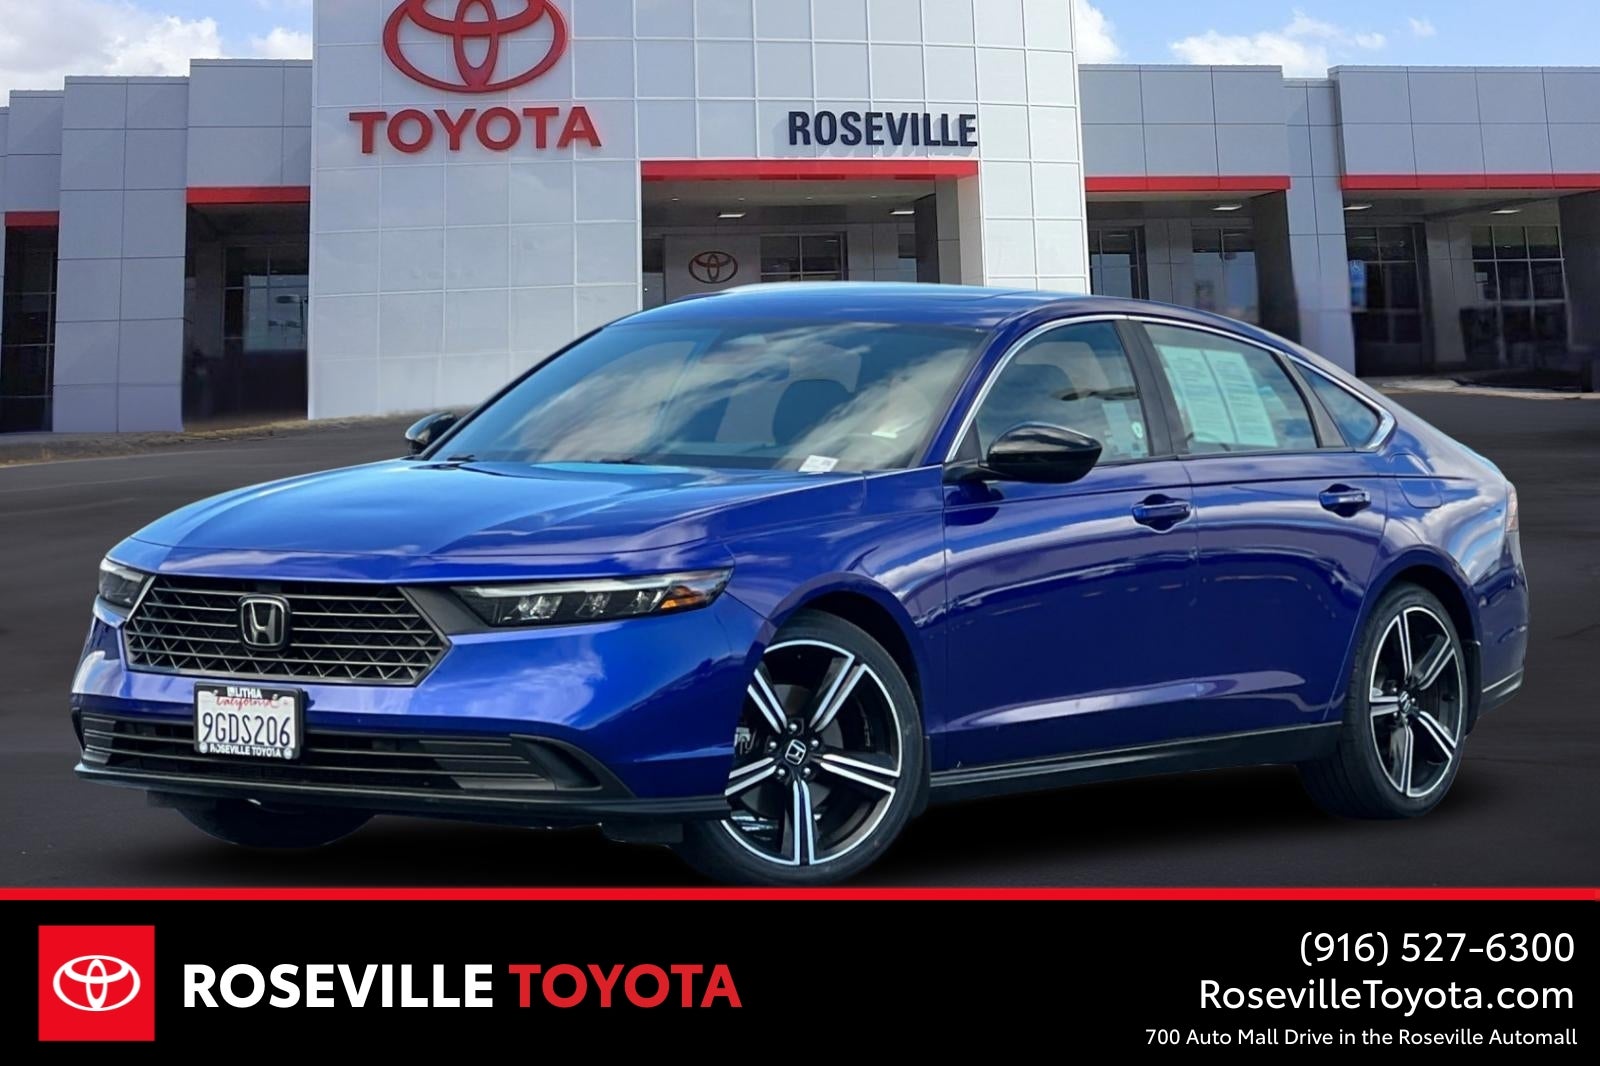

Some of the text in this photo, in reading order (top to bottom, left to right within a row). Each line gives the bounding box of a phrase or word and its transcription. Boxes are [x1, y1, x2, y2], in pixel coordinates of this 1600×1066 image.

[348, 106, 601, 154] TOYOTA
[788, 110, 978, 148] ROSEVILLE
[234, 686, 262, 699] LITHIA
[202, 712, 291, 747] 9GDS206
[209, 743, 281, 758] ROSEVILLE TOYOTA
